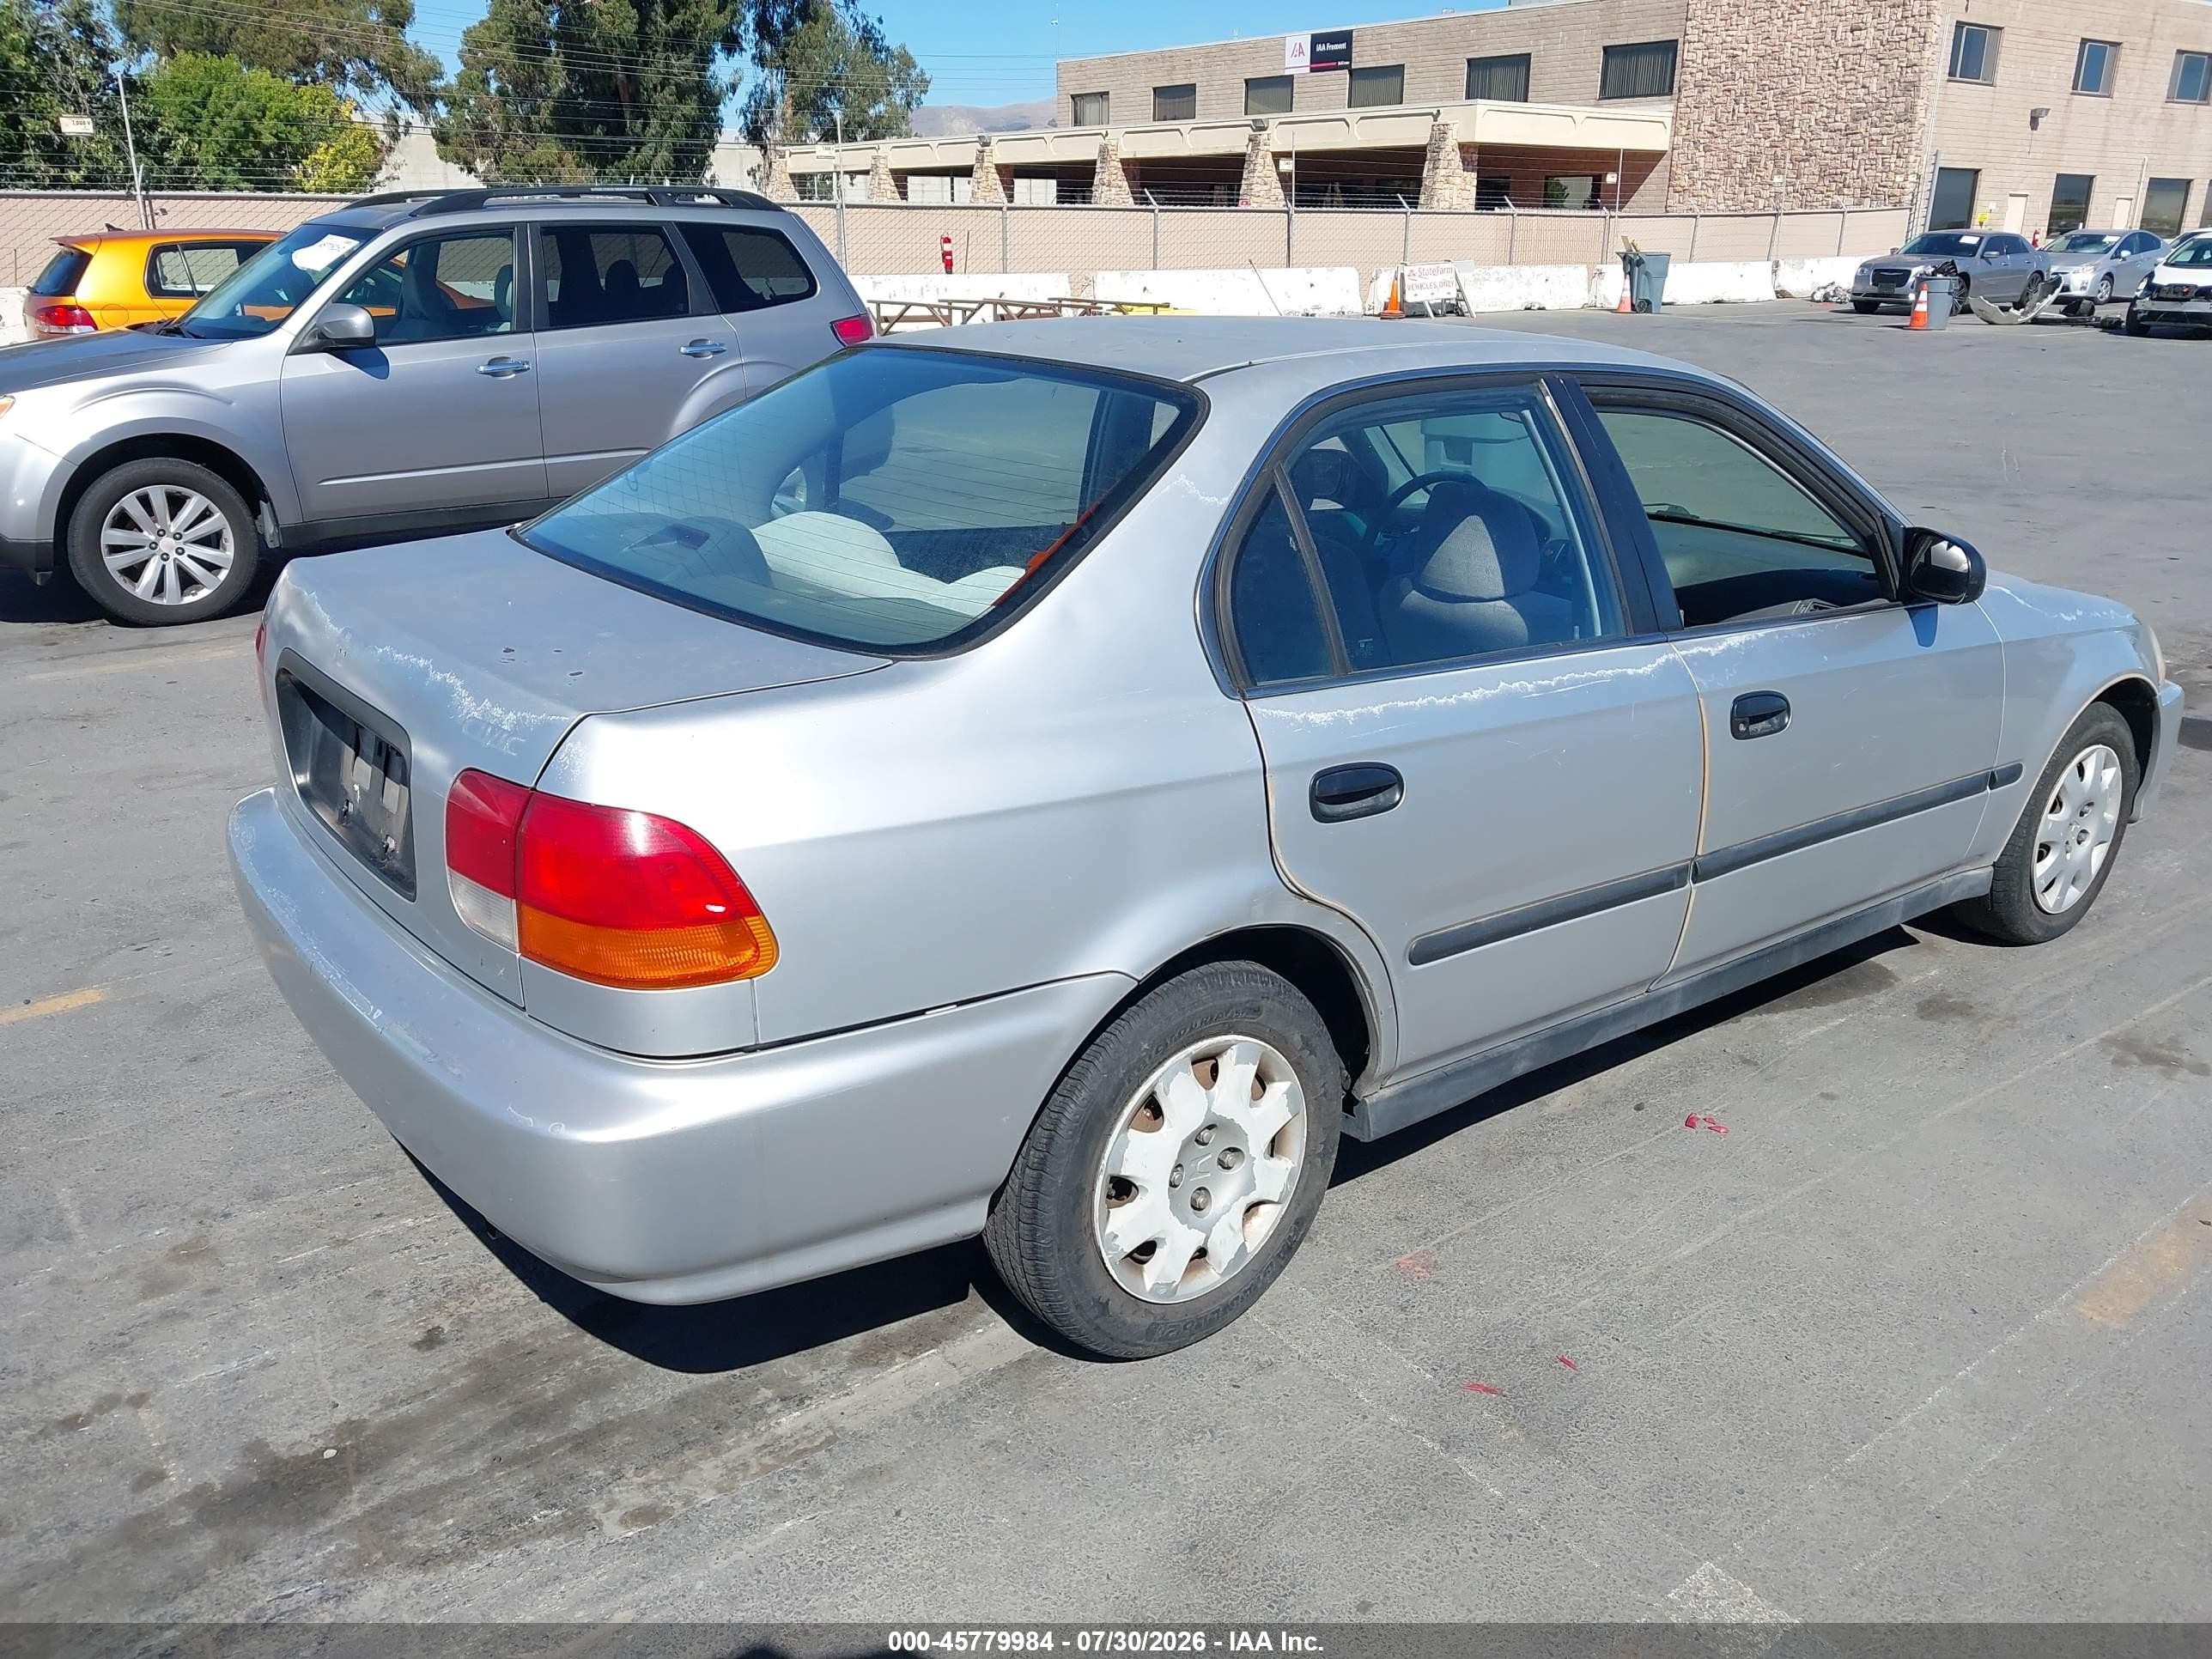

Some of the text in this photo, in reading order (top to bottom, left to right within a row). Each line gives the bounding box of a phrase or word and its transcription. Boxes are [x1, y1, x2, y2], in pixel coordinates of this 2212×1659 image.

[1316, 42, 1346, 52] IAA Fremont
[1407, 280, 1455, 291] VEHICLES ONLY
